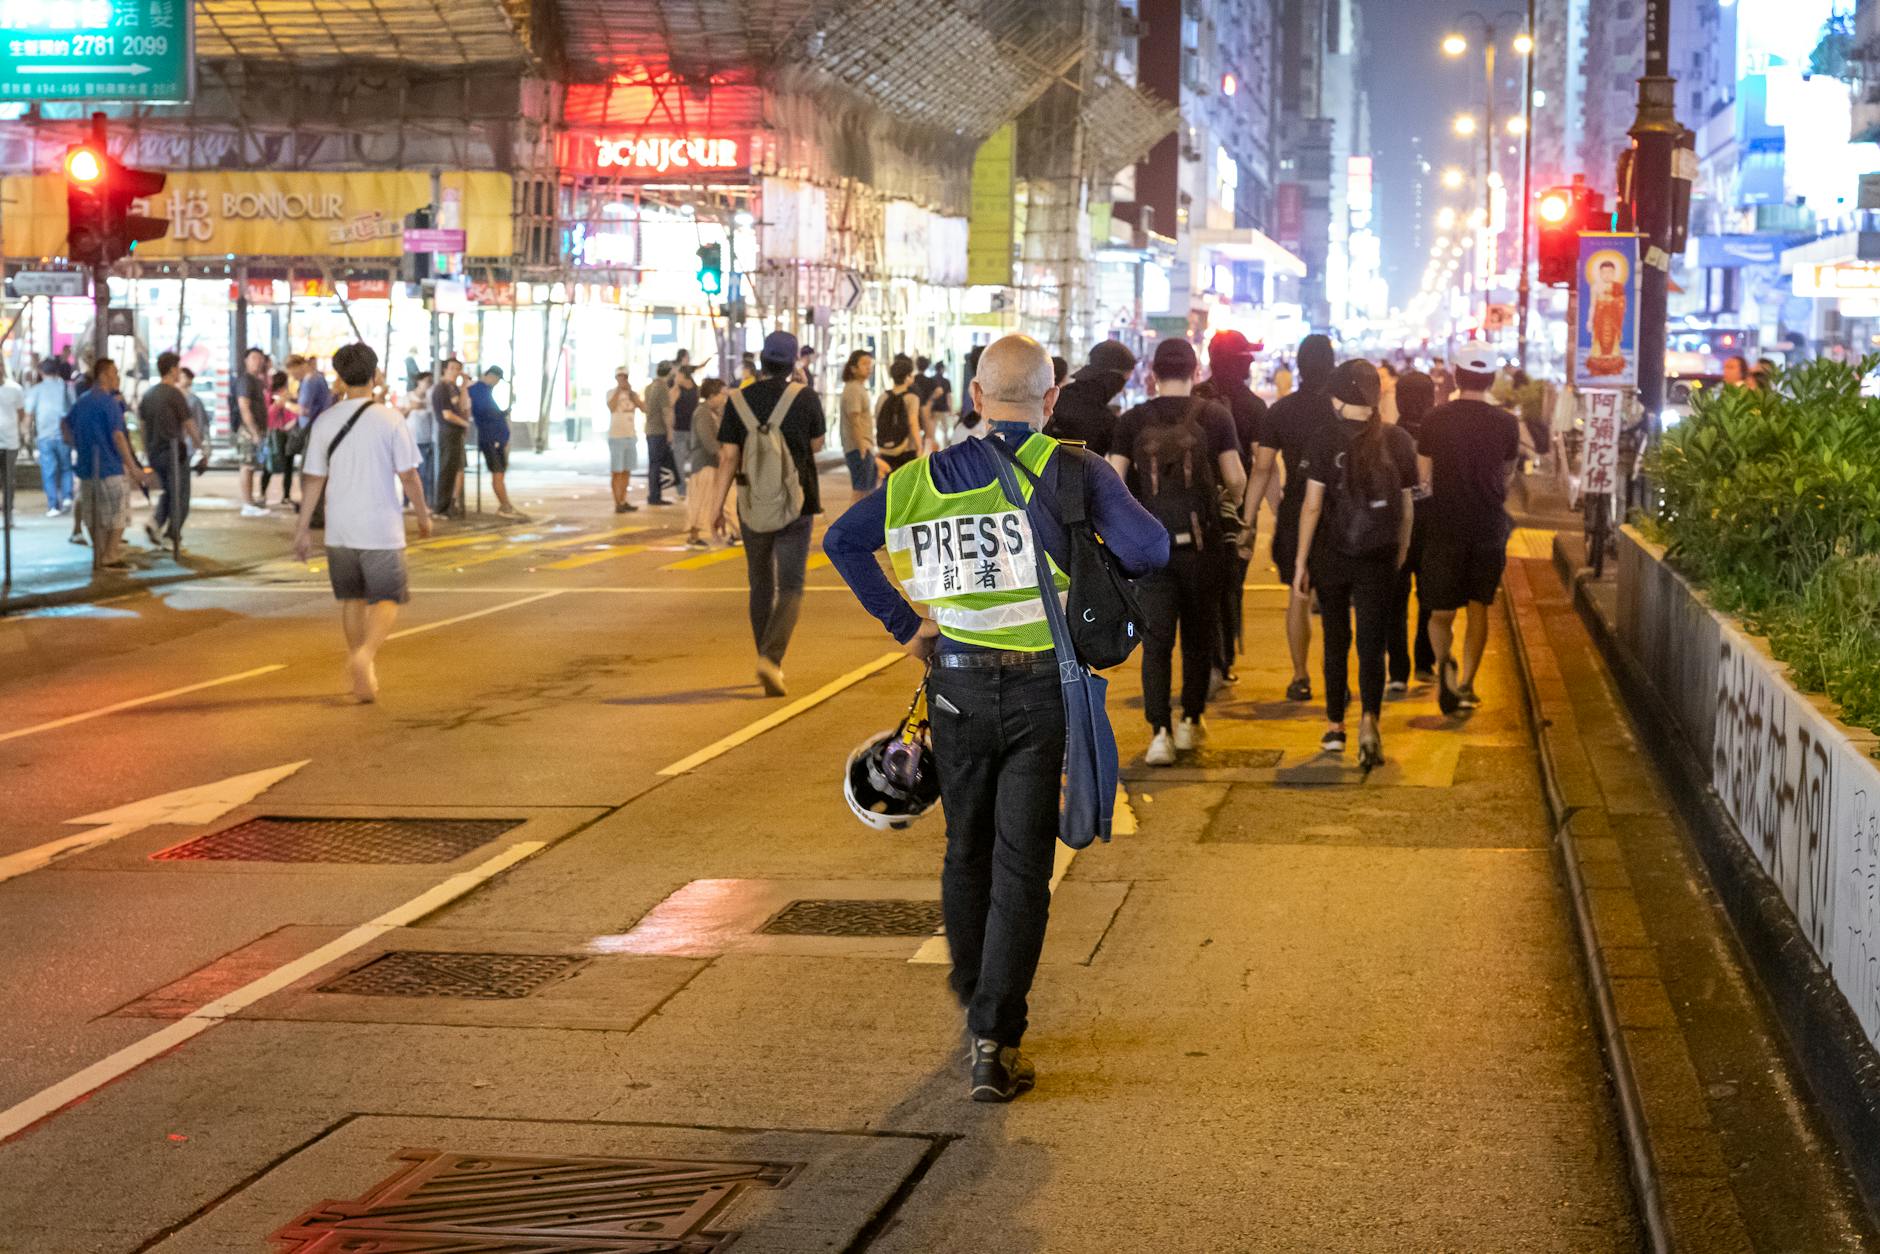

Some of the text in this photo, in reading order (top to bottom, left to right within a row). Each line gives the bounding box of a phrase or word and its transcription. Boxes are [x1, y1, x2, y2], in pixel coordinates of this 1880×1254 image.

[72, 35, 114, 56] 2781
[123, 36, 168, 56] 2099
[222, 193, 343, 222] BONJOUR
[1586, 393, 1615, 493] 阿彌陀佛
[911, 513, 1024, 567] PRESS
[942, 559, 1002, 591] 記者
